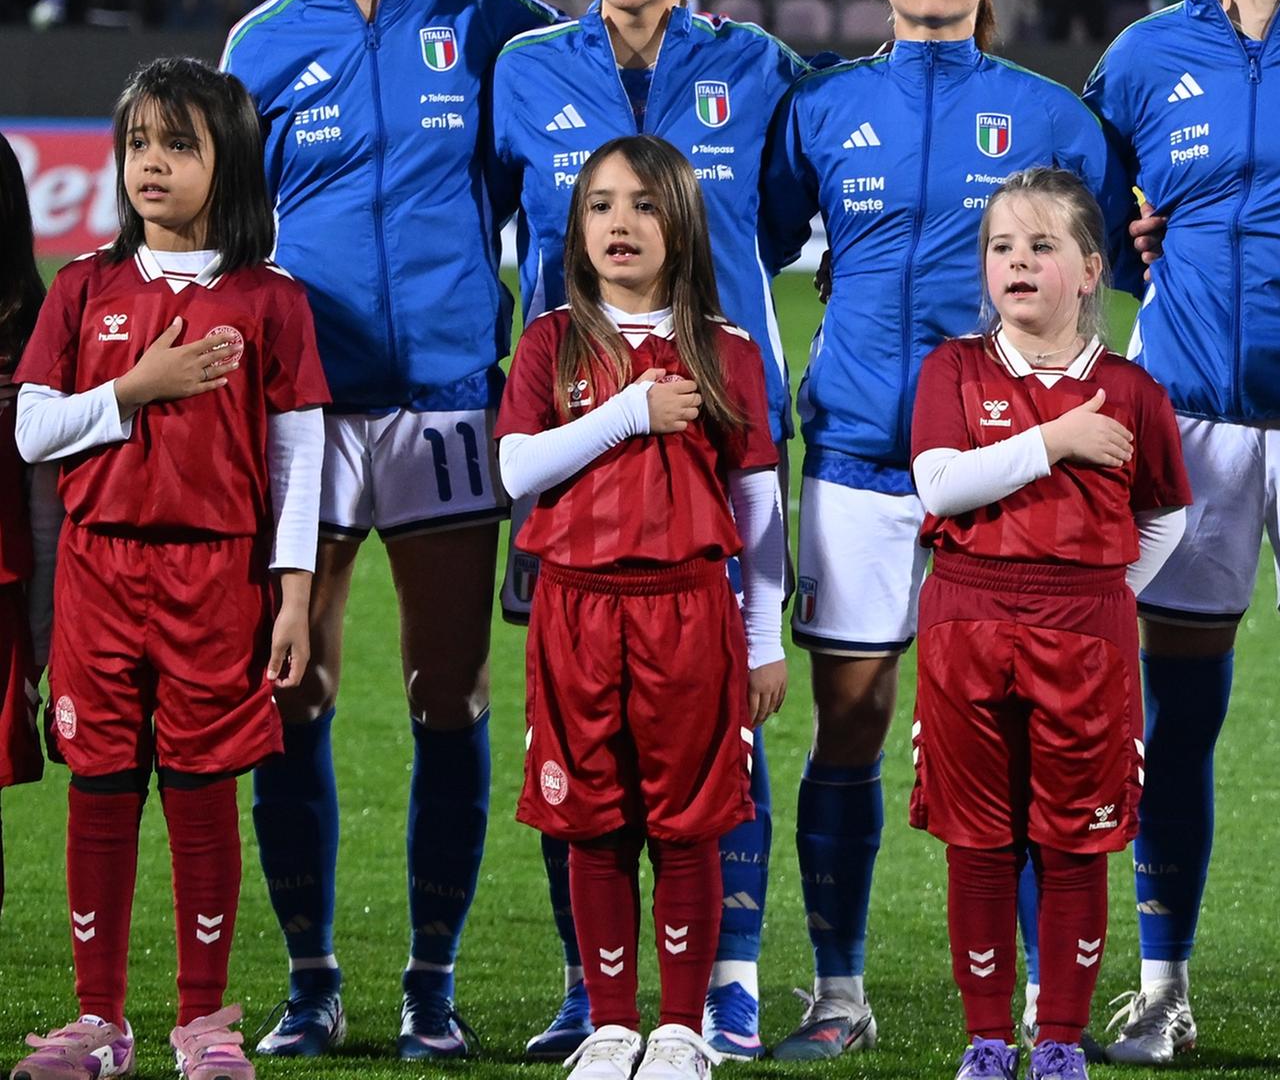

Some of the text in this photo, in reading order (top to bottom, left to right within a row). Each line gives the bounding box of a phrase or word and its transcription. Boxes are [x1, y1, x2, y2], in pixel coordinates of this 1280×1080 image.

[424, 30, 452, 41] ITALIA
[699, 85, 724, 95] ITALIA
[427, 93, 465, 103] Telepass
[312, 104, 340, 122] TIM
[421, 113, 446, 128] eni
[980, 116, 1007, 127] ITALIA
[296, 126, 341, 144] Poste
[1183, 123, 1210, 142] TIM
[699, 144, 735, 156] Telepass
[1170, 144, 1210, 165] Poste
[694, 164, 716, 180] eni
[974, 173, 1008, 185] Telepas
[857, 176, 885, 192] TIM
[843, 197, 884, 213] Poste
[963, 194, 989, 210] eni
[98, 331, 129, 342] hummel
[979, 417, 1011, 428] hummel
[423, 420, 484, 502] 11
